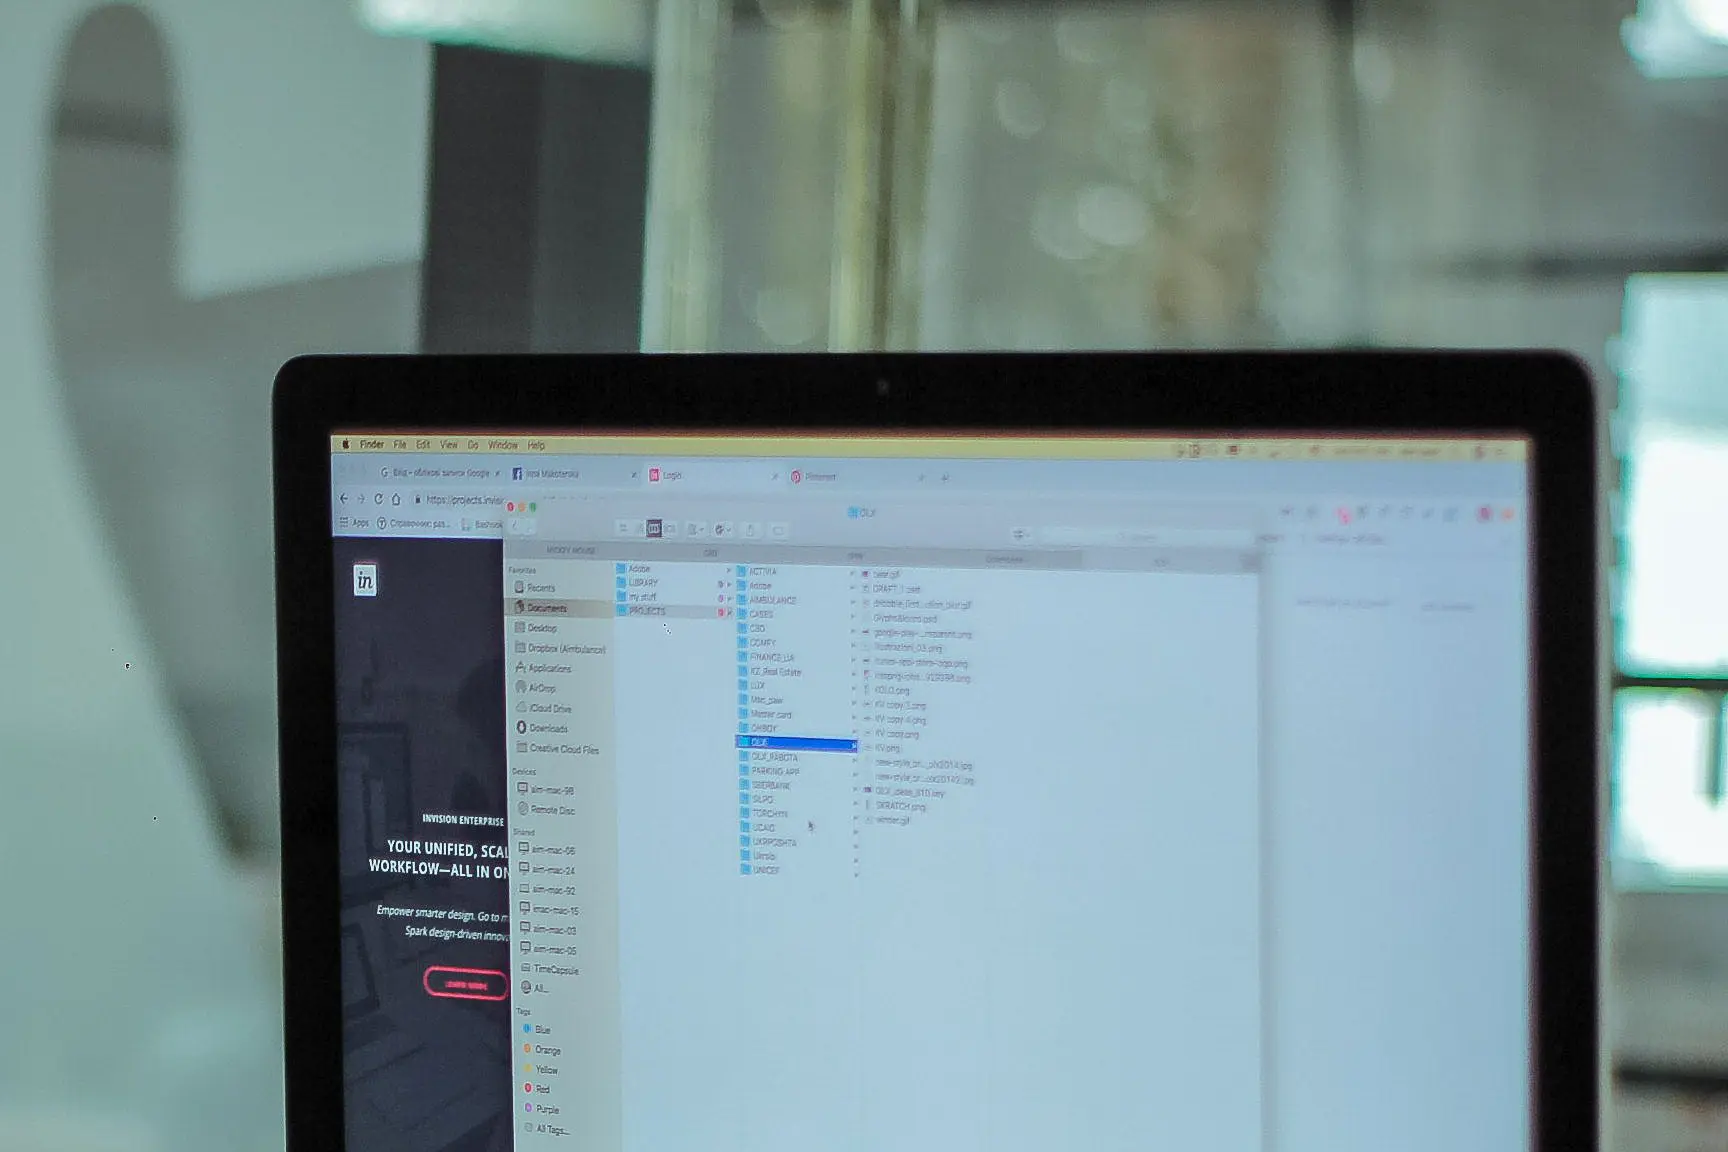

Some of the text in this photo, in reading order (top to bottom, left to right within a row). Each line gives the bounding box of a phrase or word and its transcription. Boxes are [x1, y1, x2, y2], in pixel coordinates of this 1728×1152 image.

[360, 439, 546, 451] Finder File Edit View Go Window Help
[352, 519, 369, 528] Apps
[508, 566, 537, 575] Favorites
[358, 571, 374, 589] in
[527, 583, 556, 593] Recents
[527, 603, 569, 613] Documents
[629, 606, 666, 616] PROJECTS
[527, 623, 558, 634] Desktop
[528, 643, 558, 654] Dropbox
[528, 663, 573, 674] Applications
[529, 683, 557, 694] AirDrop
[530, 703, 572, 714] iCloud Drive
[530, 724, 569, 734] Downloads
[530, 743, 600, 755] Creative Cloud Files
[512, 767, 537, 776] Devices
[531, 805, 576, 816] Remote Disc
[423, 813, 504, 827] INVISION ENTERPRISE
[513, 828, 536, 837] Shared
[387, 839, 422, 855] YOUR
[424, 841, 478, 860] UNIFIED,
[476, 865, 490, 878] IN
[377, 904, 414, 918] Empower
[415, 908, 447, 919] smarter
[448, 909, 475, 922] design.
[477, 911, 489, 922] Go
[491, 912, 500, 922] to
[405, 925, 428, 938] Spark
[429, 926, 482, 940] design-driven
[533, 963, 580, 976] TimeCapsule
[516, 1006, 531, 1017] Tags
[535, 1024, 551, 1035] Blue
[535, 1044, 561, 1057] Orange
[536, 1064, 558, 1075] Yellow
[536, 1084, 550, 1094] Red
[536, 1103, 560, 1115] Purple
[537, 1123, 546, 1133] All
